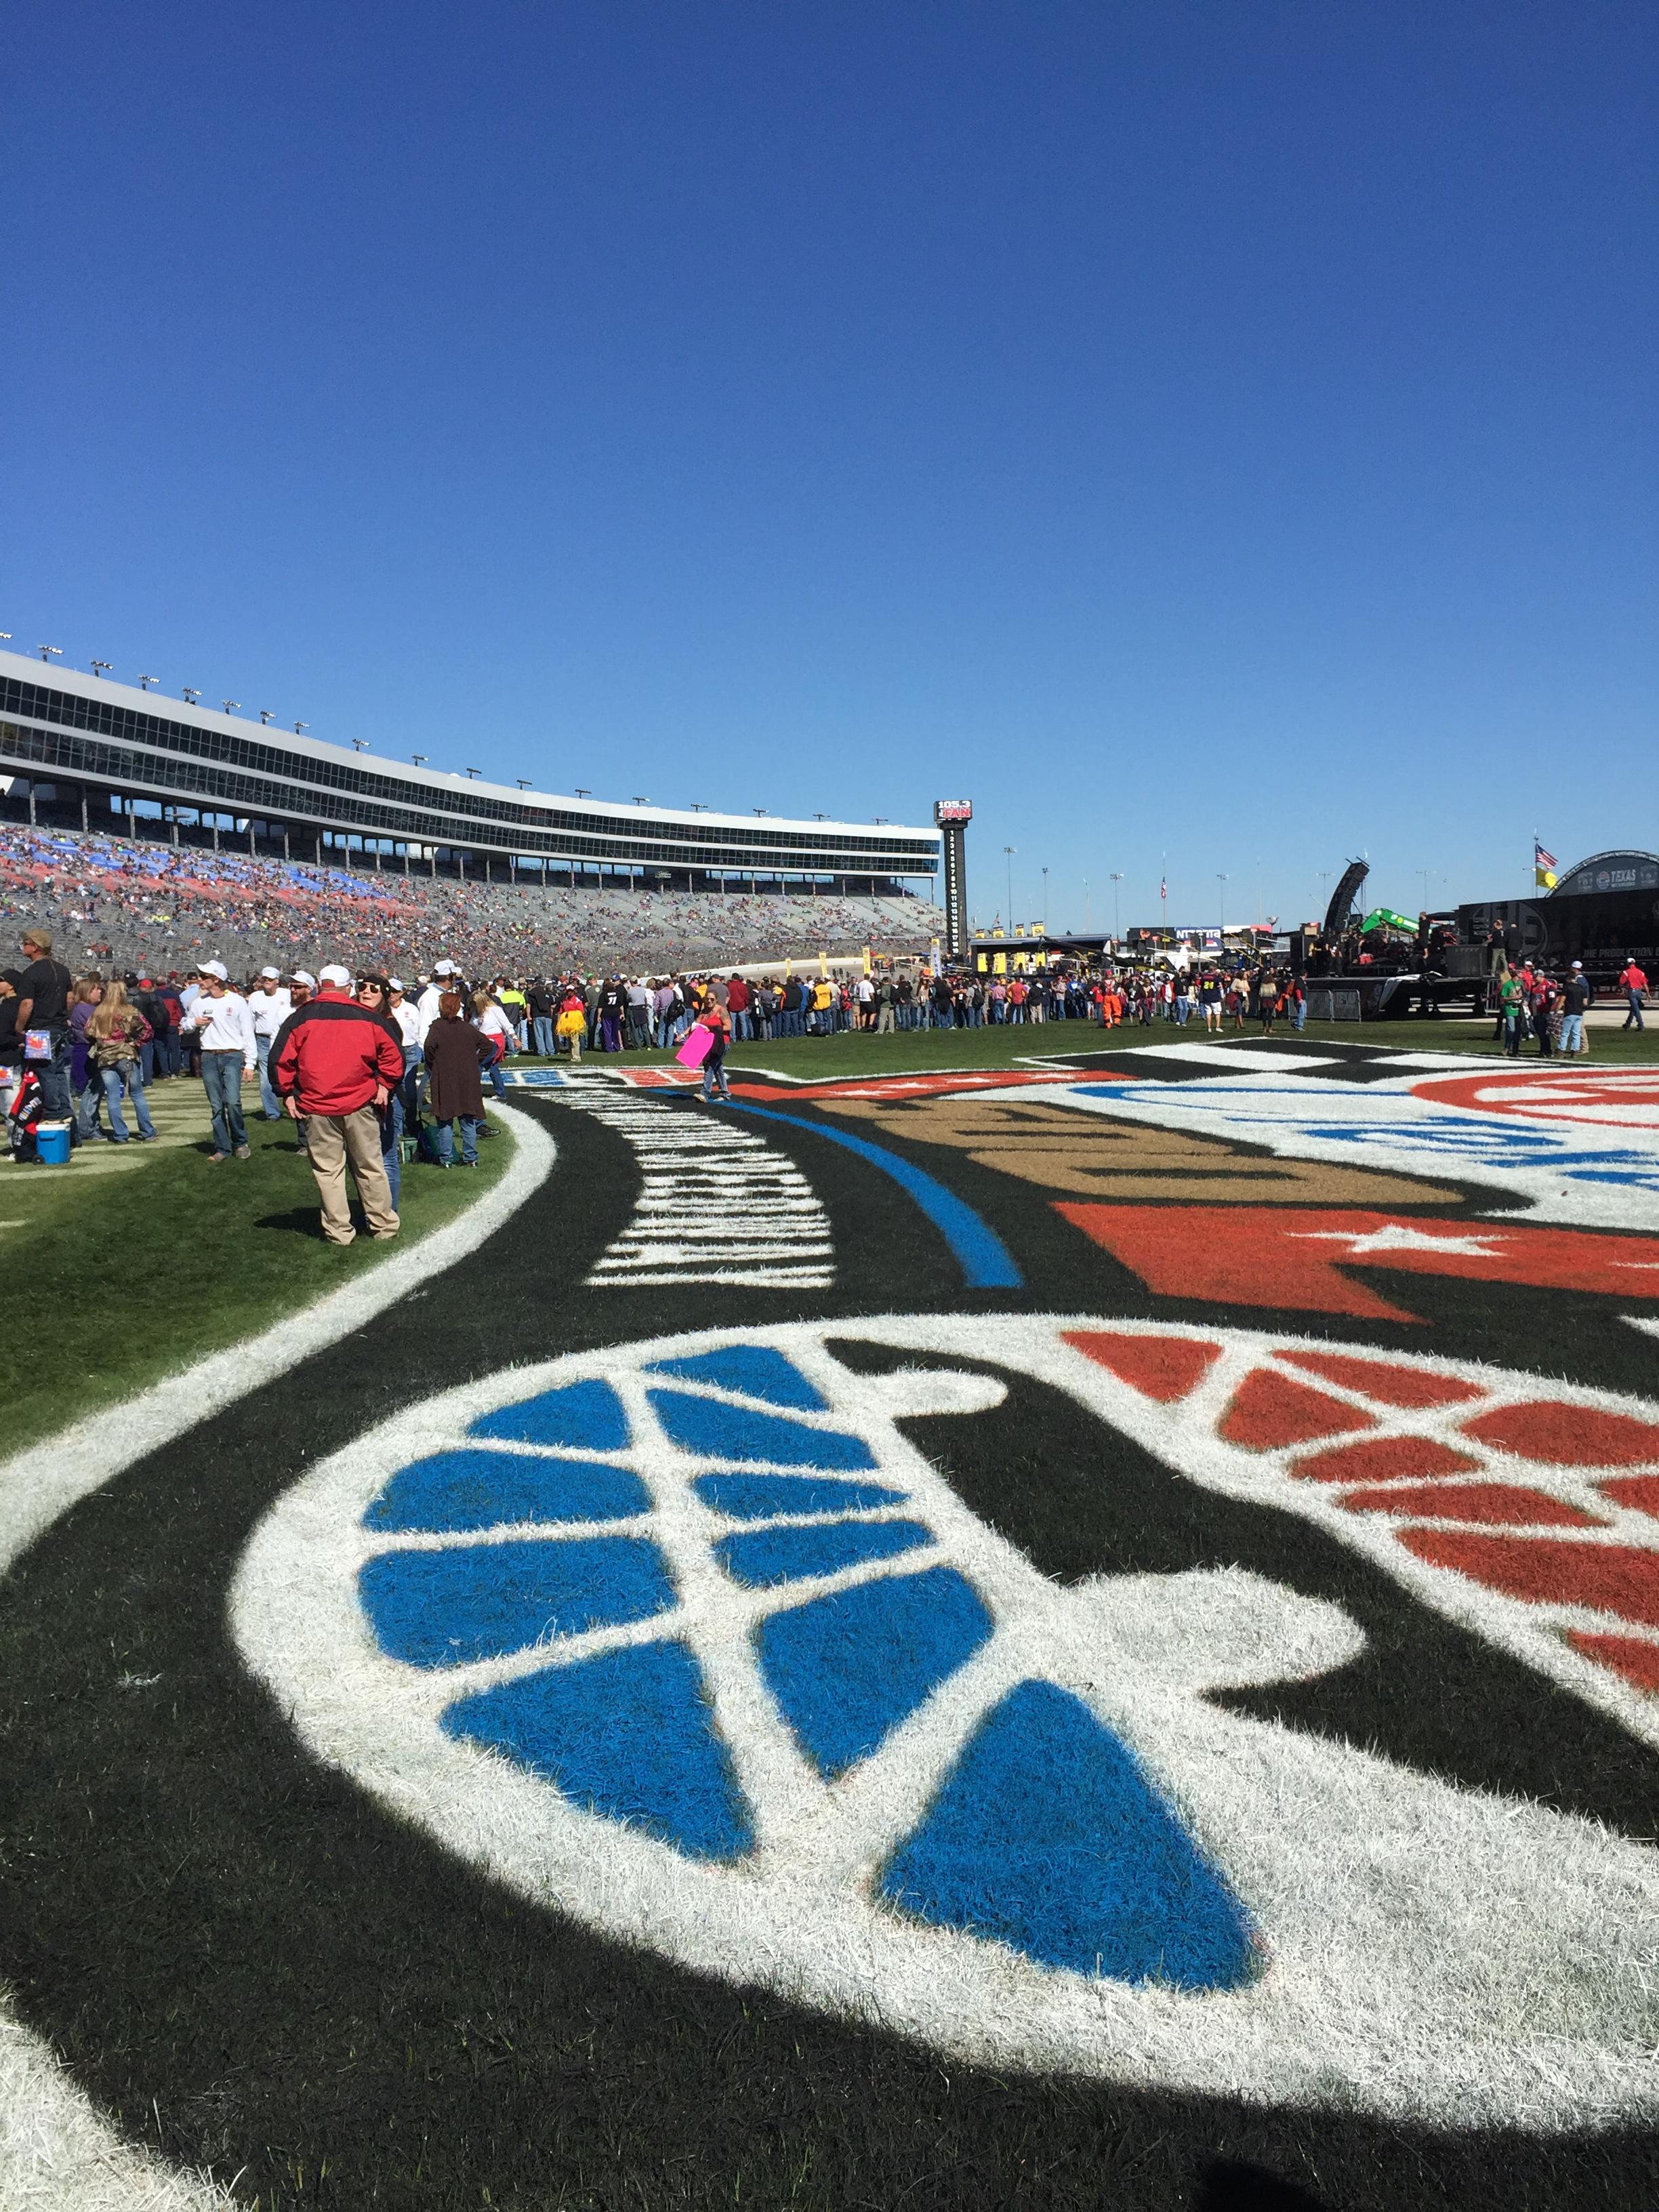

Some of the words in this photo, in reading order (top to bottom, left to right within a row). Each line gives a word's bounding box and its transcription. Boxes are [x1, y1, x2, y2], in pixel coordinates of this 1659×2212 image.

[938, 800, 970, 808] 105.3
[943, 808, 970, 818] FAN
[1612, 869, 1636, 882] TEXAS
[1599, 947, 1654, 958] PRODUCTION
[587, 1111, 767, 1150] MOTOR
[809, 1098, 1465, 1204] 500
[583, 1151, 839, 1288] SPEEDWAY
